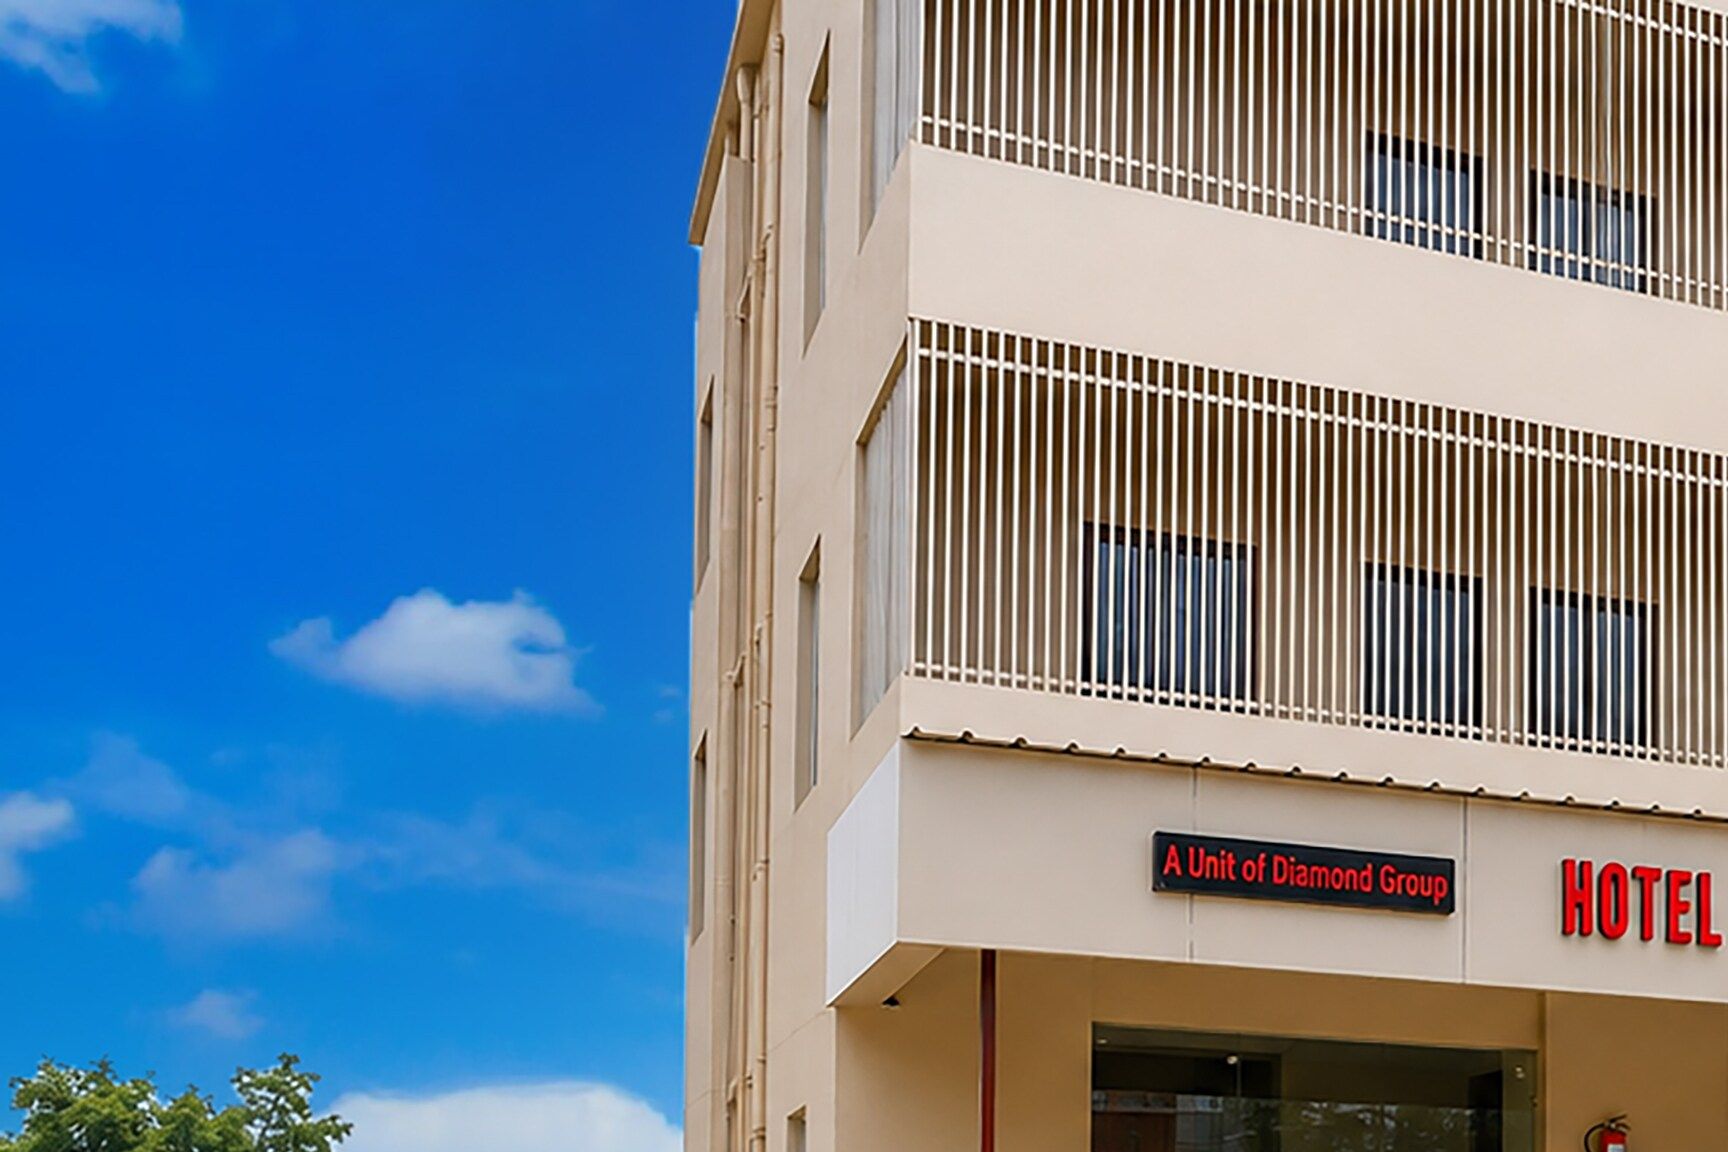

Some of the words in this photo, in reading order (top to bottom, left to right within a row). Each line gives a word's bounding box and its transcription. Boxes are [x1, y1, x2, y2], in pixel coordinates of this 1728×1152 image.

[1163, 844, 1182, 876] A
[1188, 847, 1236, 881] Unit
[1241, 853, 1266, 883] of
[1272, 855, 1373, 892] Diamond
[1379, 865, 1449, 906] Group
[1561, 858, 1723, 948] HOTEL
